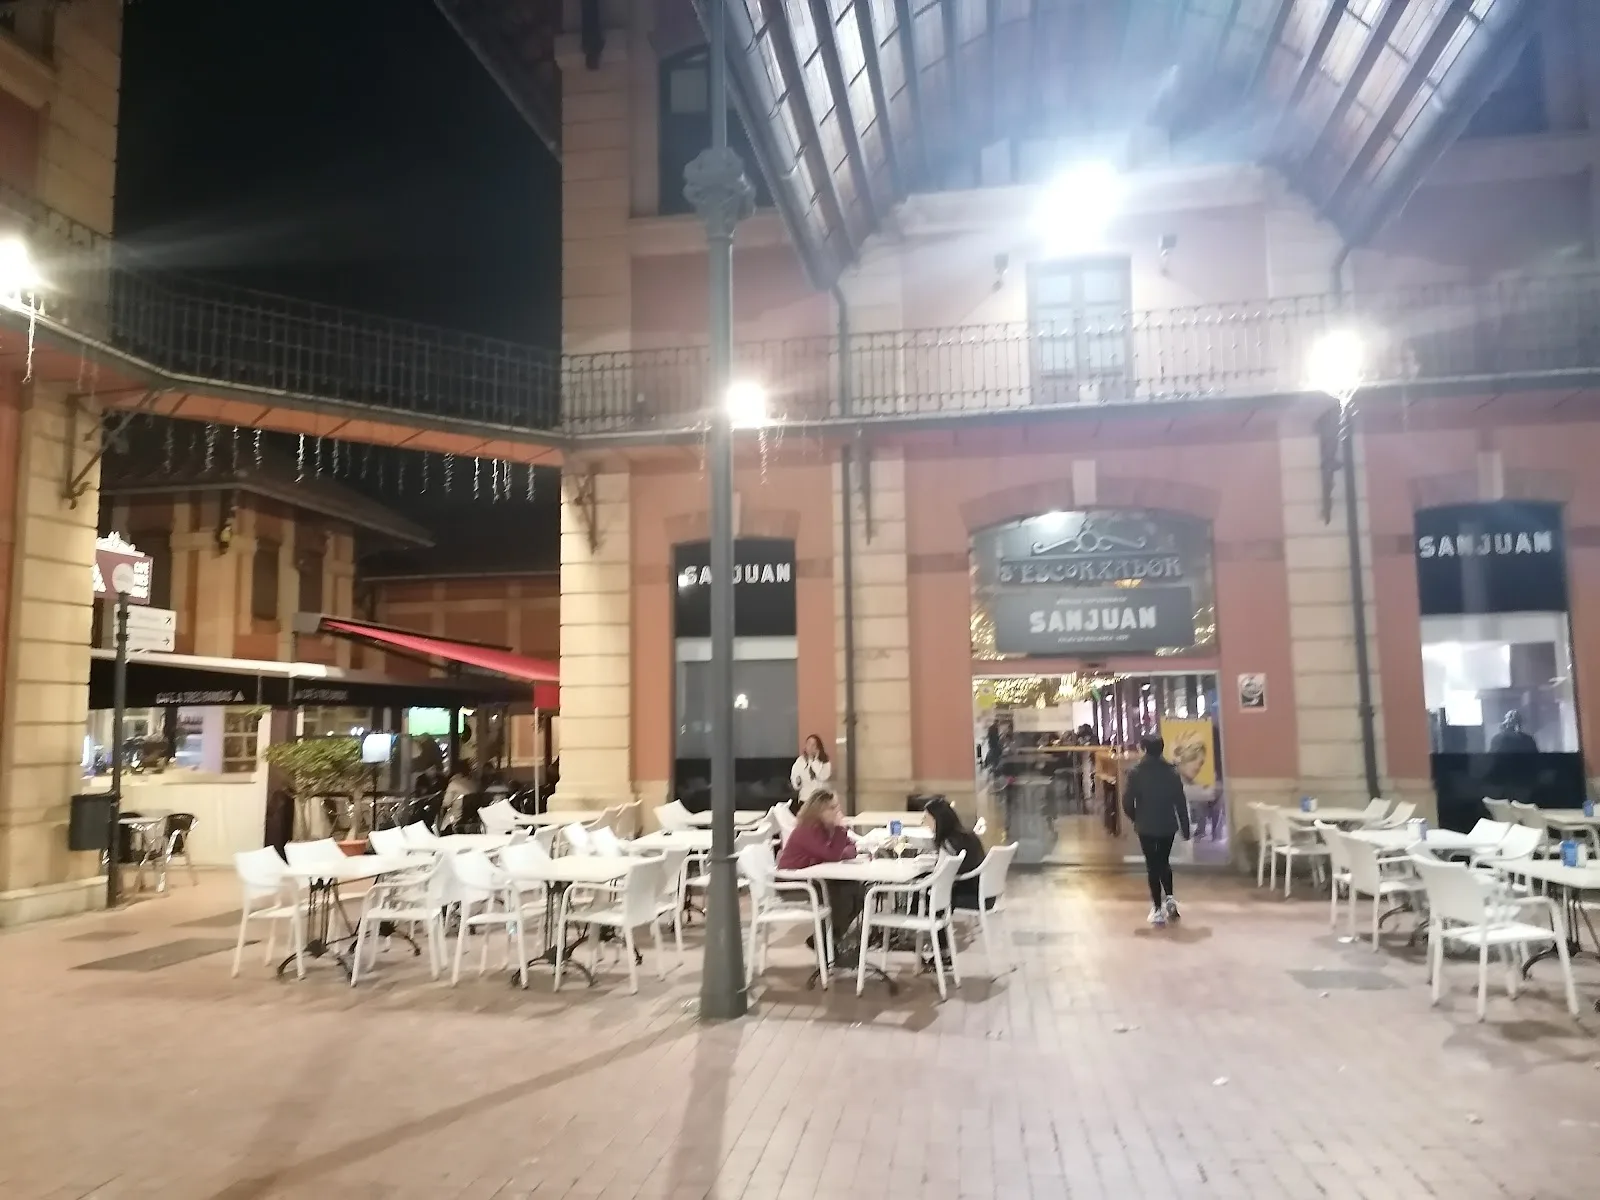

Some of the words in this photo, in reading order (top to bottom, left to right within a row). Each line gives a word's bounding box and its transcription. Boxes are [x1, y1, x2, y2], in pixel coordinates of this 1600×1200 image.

[1418, 530, 1553, 559] SANJUAN
[683, 562, 791, 585] SAJUAN
[1029, 605, 1158, 634] SANJUAN
